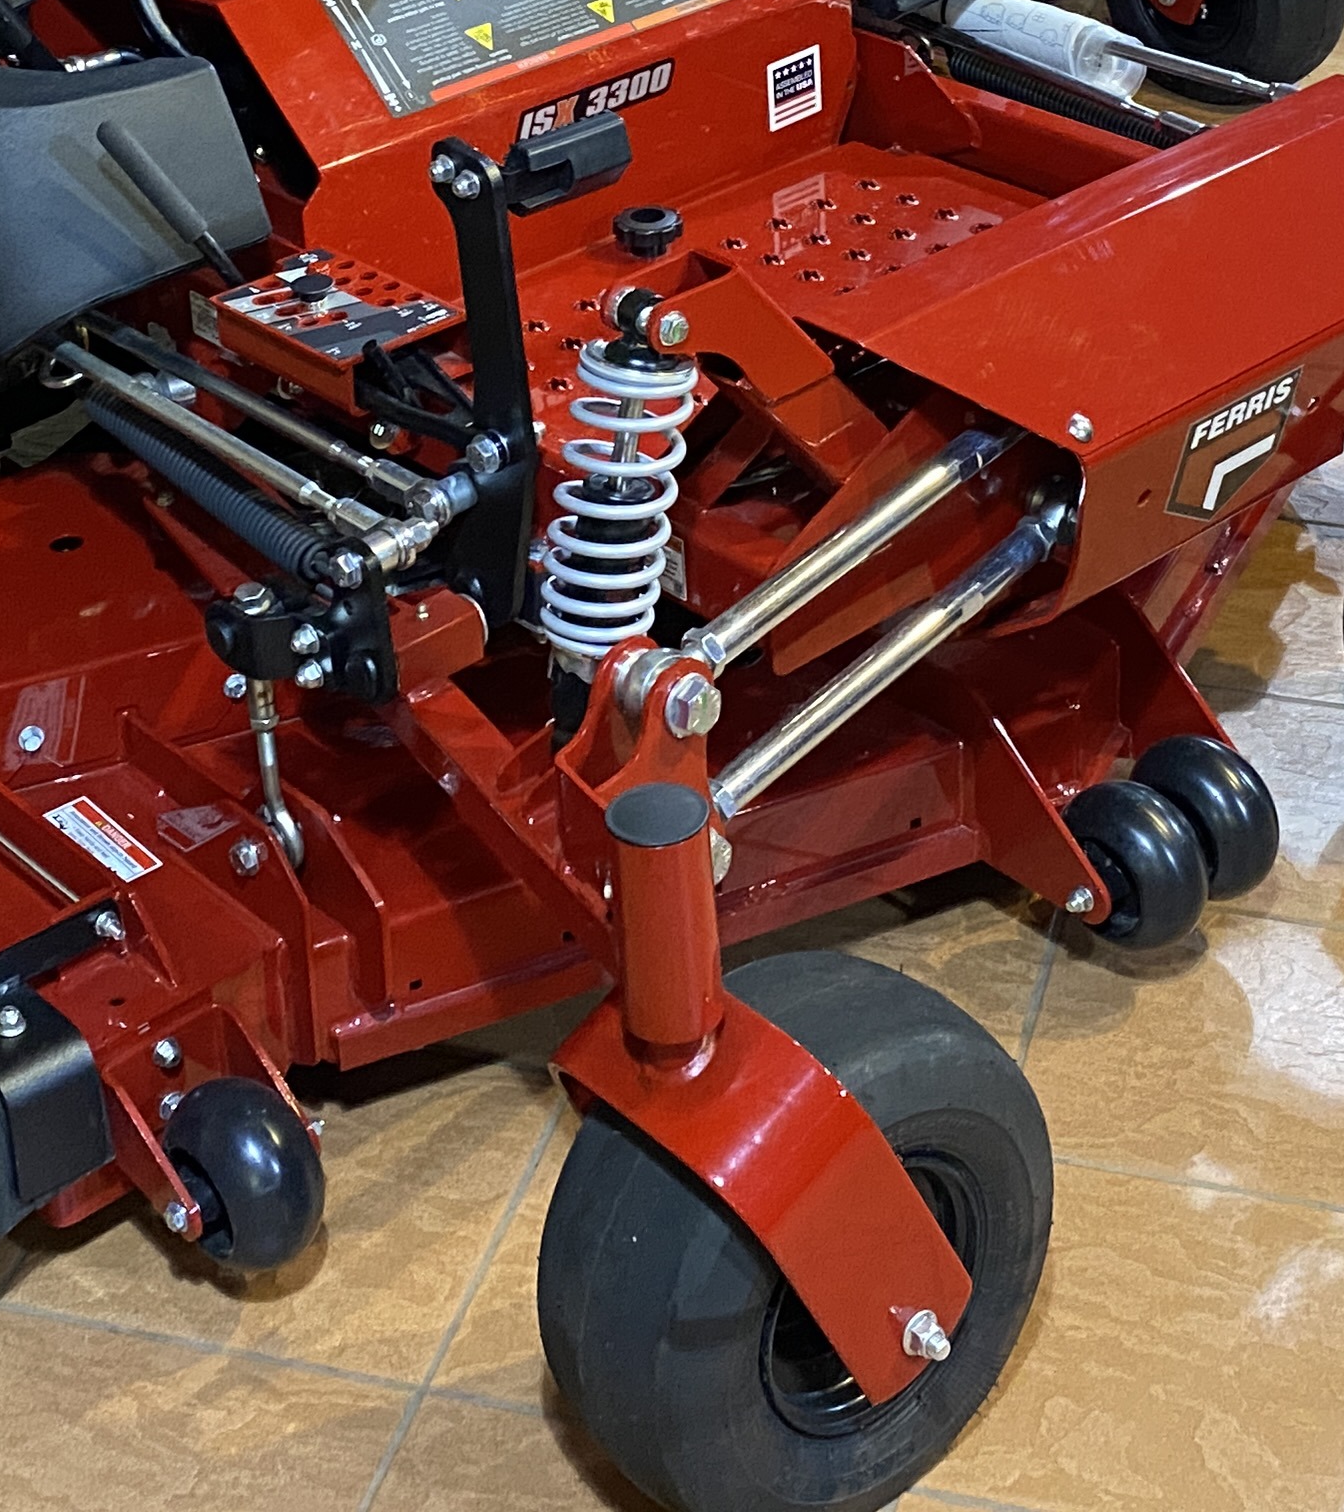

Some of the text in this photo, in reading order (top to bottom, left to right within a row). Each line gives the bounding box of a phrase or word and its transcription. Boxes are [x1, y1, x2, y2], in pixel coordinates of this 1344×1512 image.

[520, 61, 673, 139] ISX 3300
[796, 78, 813, 91] USA
[1190, 376, 1294, 450] FERRIS
